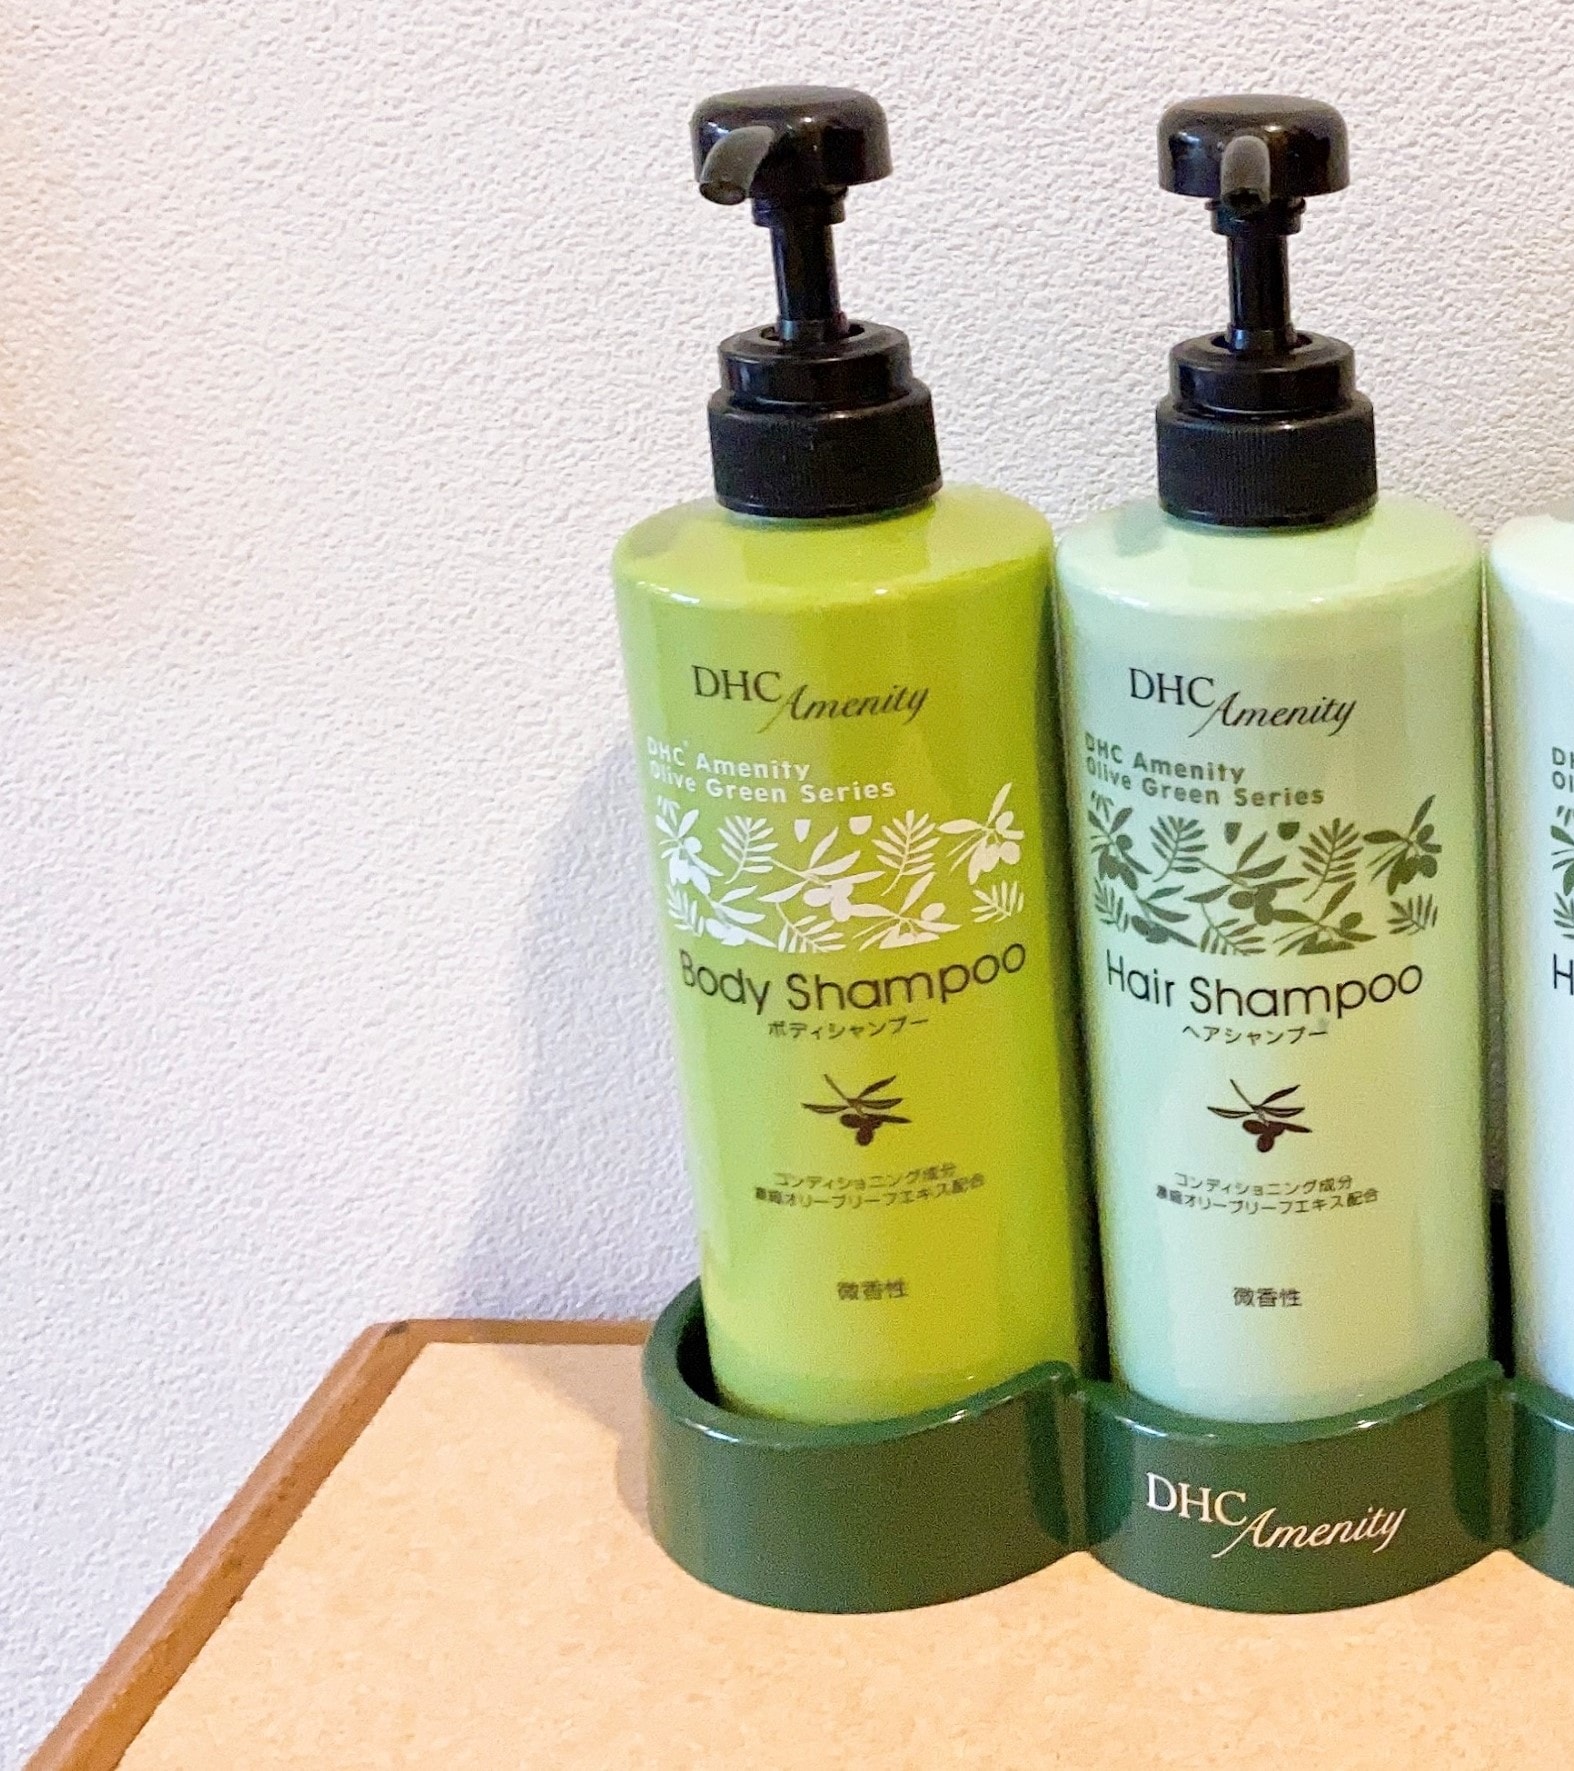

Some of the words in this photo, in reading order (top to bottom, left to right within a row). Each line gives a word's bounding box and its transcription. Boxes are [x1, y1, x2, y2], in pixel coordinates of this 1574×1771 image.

[692, 665, 781, 702] DHC
[756, 684, 930, 733] Amenity
[1129, 667, 1215, 708] DHC
[1188, 691, 1356, 737] Amenity
[647, 736, 685, 766] DHC
[696, 752, 811, 781] Amenity
[650, 760, 696, 792] Olive
[706, 778, 787, 803] Green
[800, 781, 896, 804] Series
[1085, 731, 1123, 764] DHC
[1133, 752, 1245, 784] Amenity
[1086, 756, 1131, 790] Olive
[1142, 778, 1220, 805] Green
[1234, 787, 1325, 808] Series
[680, 949, 770, 1015] Body
[786, 943, 1026, 1011] Shampoo
[1107, 950, 1175, 1008] Hair
[1190, 965, 1423, 1019] Shampoo
[768, 1015, 928, 1040] ボディシャンプー
[1182, 1025, 1328, 1046] ヘアシャンプー
[1174, 1172, 1353, 1196] コンディショニング成分
[1233, 1287, 1302, 1308] 微香性
[1145, 1471, 1248, 1527] DHC
[1211, 1504, 1408, 1559] Amenity
